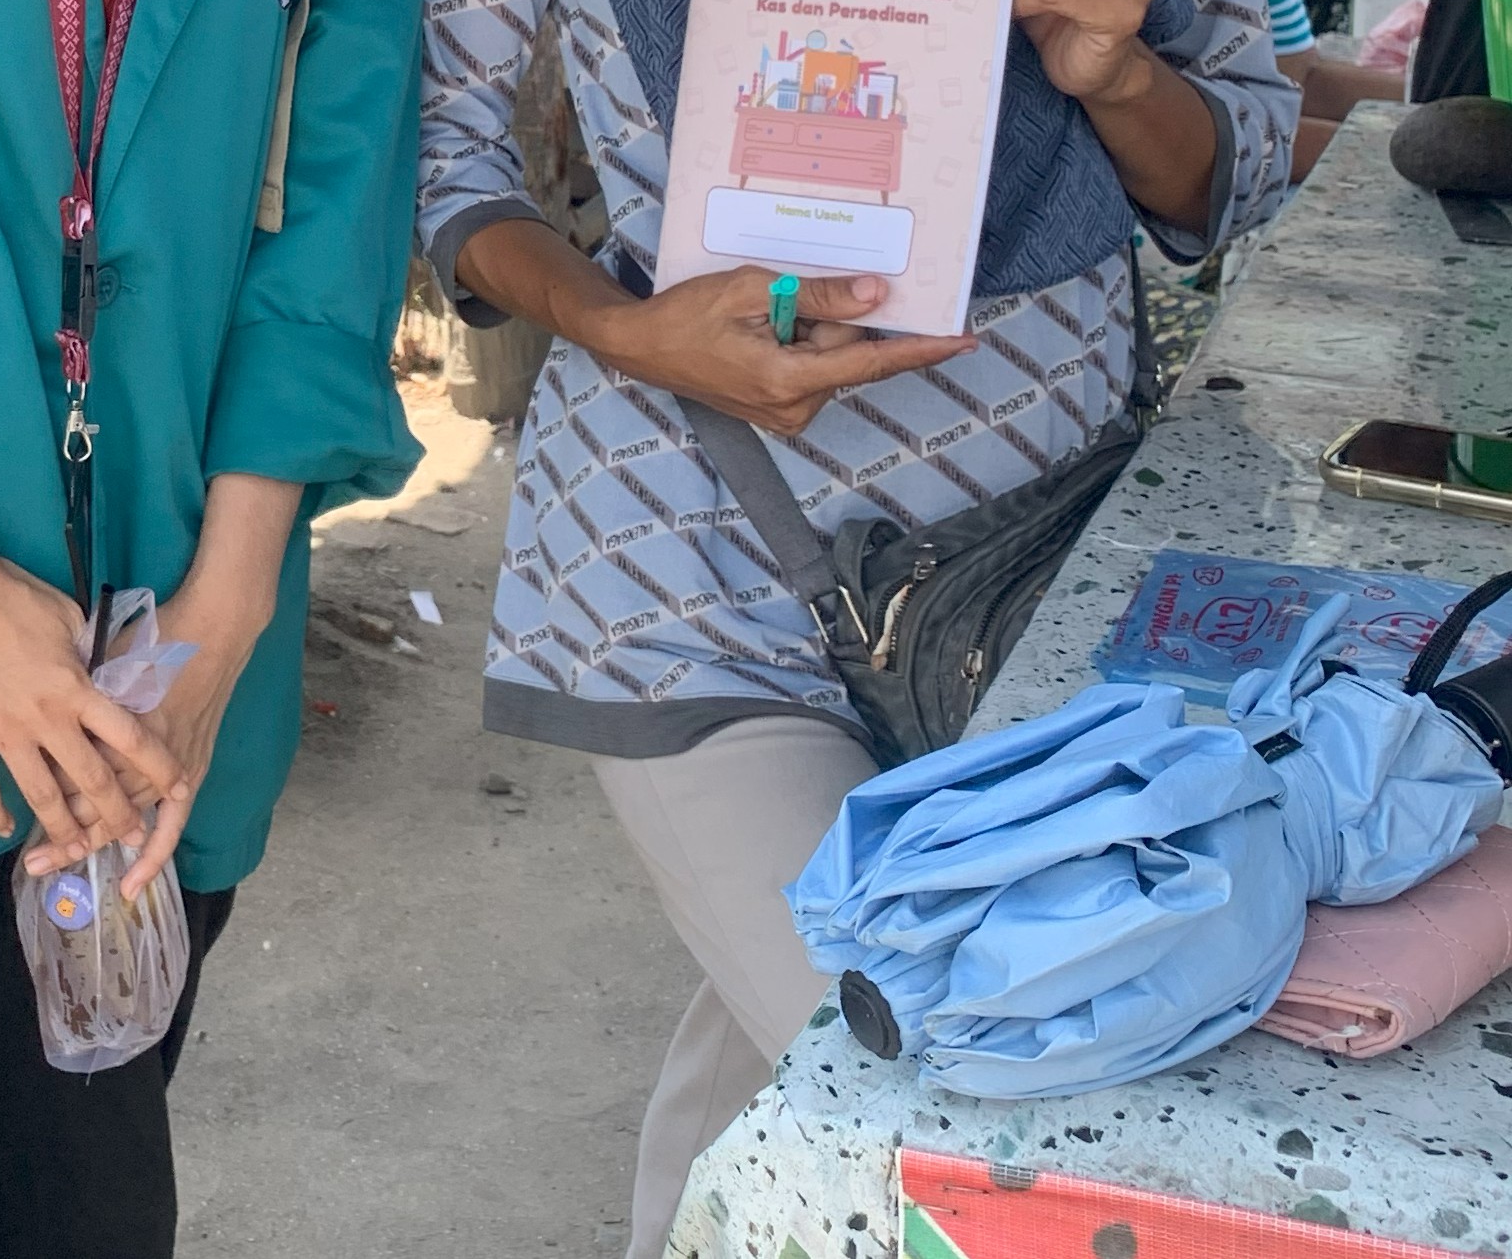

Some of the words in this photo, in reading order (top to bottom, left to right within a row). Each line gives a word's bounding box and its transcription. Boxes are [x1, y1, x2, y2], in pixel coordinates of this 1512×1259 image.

[828, 2, 930, 25] Persediaan
[1204, 32, 1251, 71] VALENSIAGA
[774, 202, 812, 221] Nama
[815, 205, 855, 225] Usaha
[973, 295, 1022, 328] VALENSIAGA
[987, 333, 1043, 383] VALENSIAGA
[924, 367, 979, 413] VALENSIAGA
[991, 389, 1037, 421] VALENSIAGA
[852, 396, 910, 447] VALENSIAGA
[925, 421, 973, 453] VALENSIAGA
[610, 438, 660, 463] VALENSIAGA
[856, 451, 901, 484] VALENSIAGA
[619, 467, 666, 517] VALENSIAGA
[937, 456, 983, 503] VALENSIAGA
[605, 522, 653, 550] VALENSIAGA
[729, 528, 782, 579] VALENSIAGA
[616, 555, 669, 607] VALENSIAGA
[611, 611, 661, 637] VALENSIAGA
[1205, 599, 1260, 643] 212
